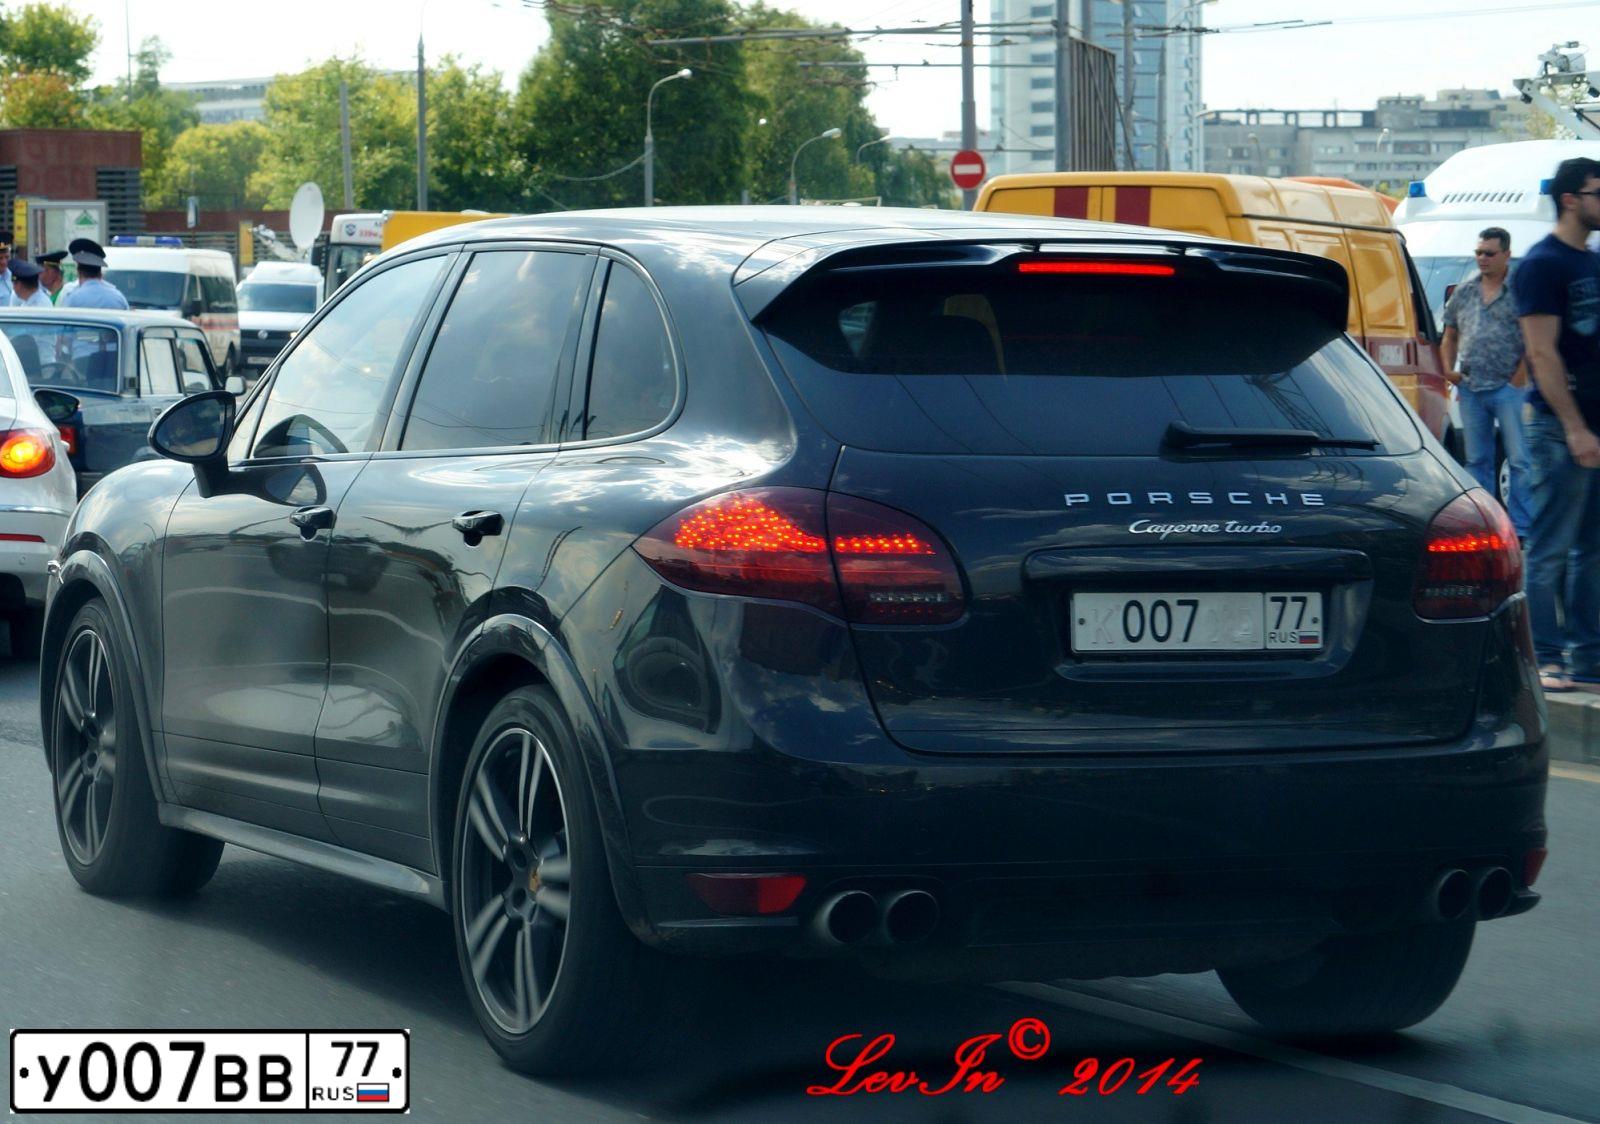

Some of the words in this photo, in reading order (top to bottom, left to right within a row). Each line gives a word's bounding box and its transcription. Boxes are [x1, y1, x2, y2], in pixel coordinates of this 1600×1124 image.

[1064, 492, 1325, 506] PORSCHE
[1128, 519, 1221, 540] Cayenne
[1225, 520, 1282, 534] turbo
[1270, 596, 1308, 630] 77
[1269, 632, 1298, 643] RUS
